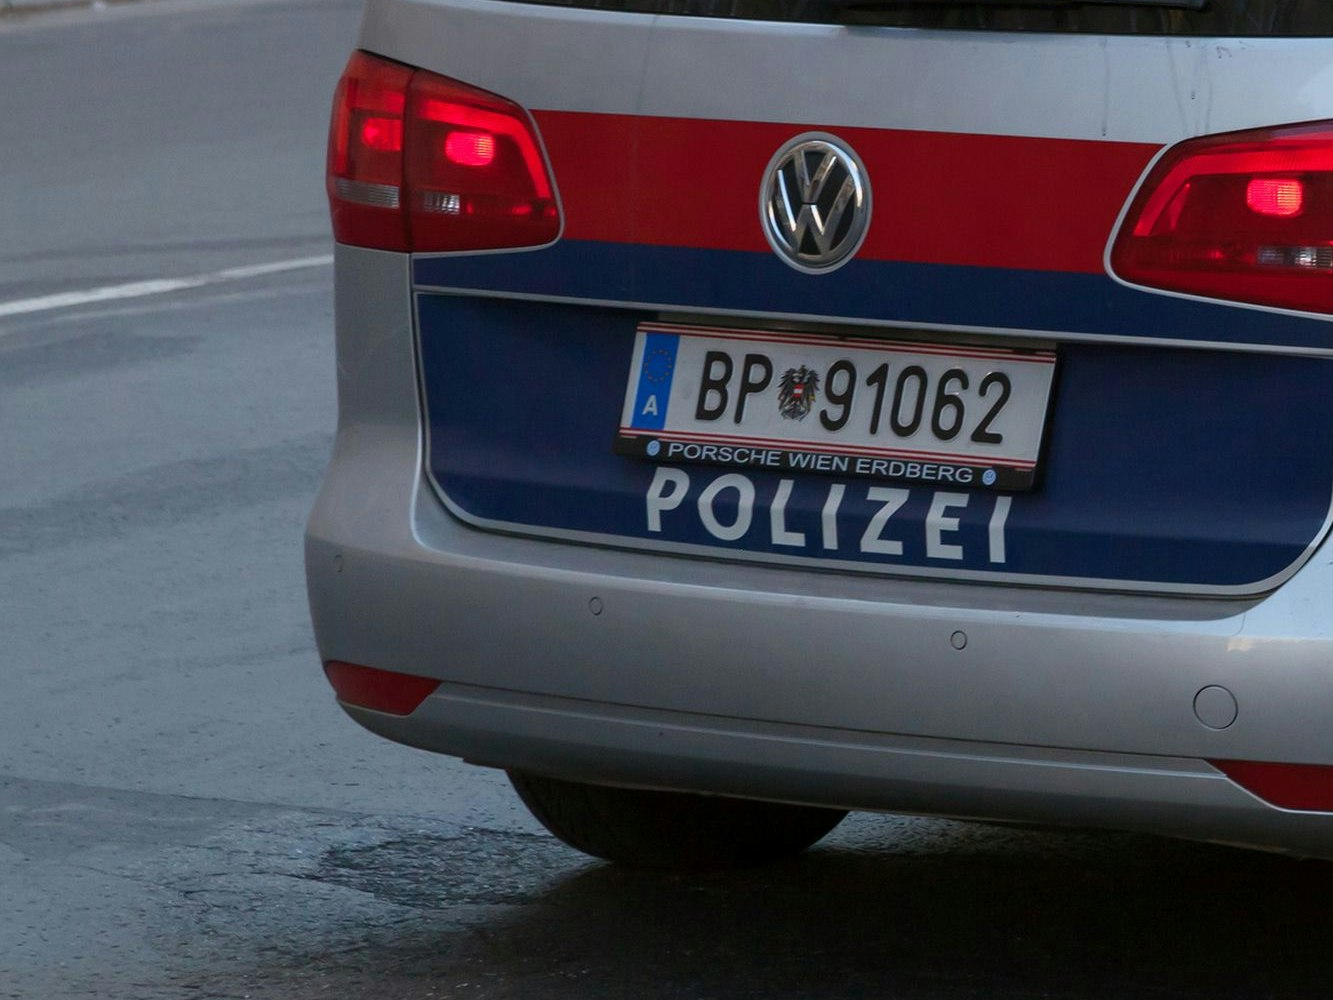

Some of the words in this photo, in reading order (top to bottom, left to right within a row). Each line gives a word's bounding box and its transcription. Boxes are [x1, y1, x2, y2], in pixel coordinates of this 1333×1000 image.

[642, 394, 658, 416] A
[695, 350, 774, 425] BP
[819, 359, 1012, 444] 91062
[667, 442, 781, 467] PORSCHE
[789, 453, 849, 473] WIEN
[855, 458, 973, 484] ERDBERG
[646, 466, 1013, 564] POLIZEI
